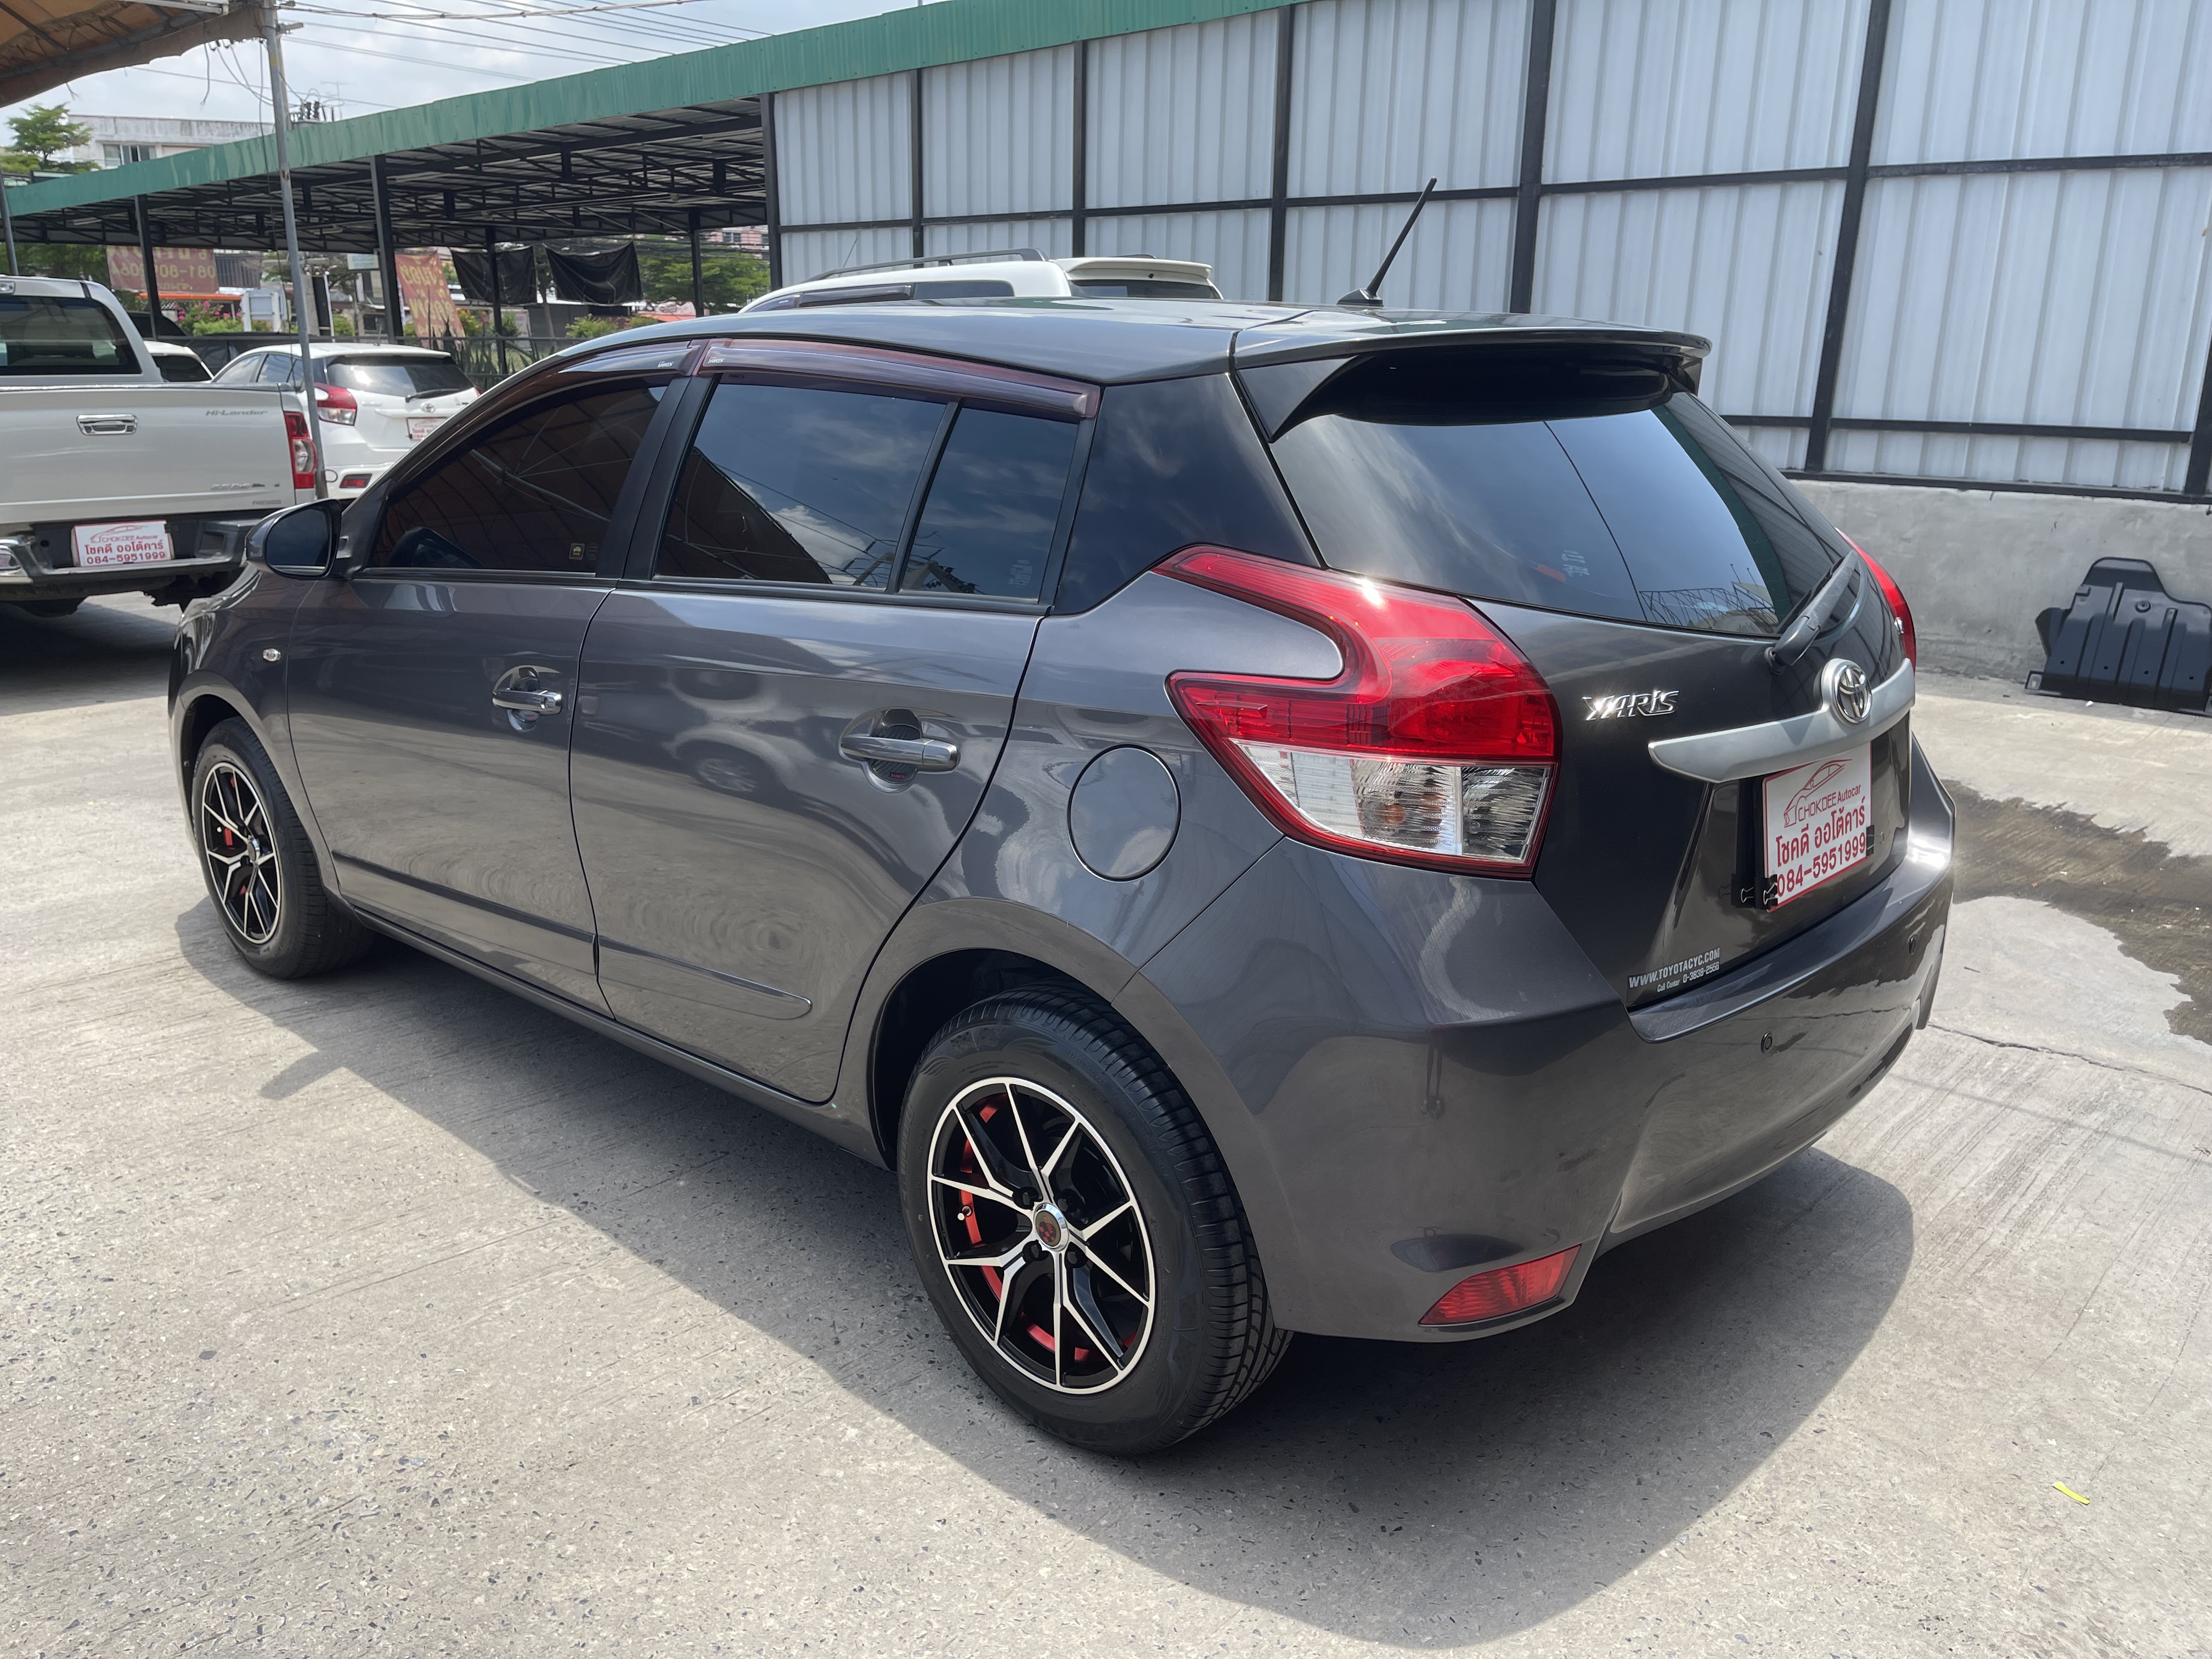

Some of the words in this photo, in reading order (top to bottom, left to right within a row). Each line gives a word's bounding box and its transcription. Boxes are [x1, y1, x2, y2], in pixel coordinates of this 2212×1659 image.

[84, 543, 112, 555] โชคดี
[87, 551, 165, 565] 084-5951999
[1582, 690, 1679, 721] YARIS
[1798, 792, 1836, 822] CHOKDEE
[1838, 785, 1861, 804] Autocar
[1776, 823, 1809, 867] โชคดี
[1815, 796, 1865, 848] ออโต้คาร์
[1777, 832, 1865, 897] 084-5951999
[1629, 947, 1720, 988] WWW.TOYOTACYC.COM
